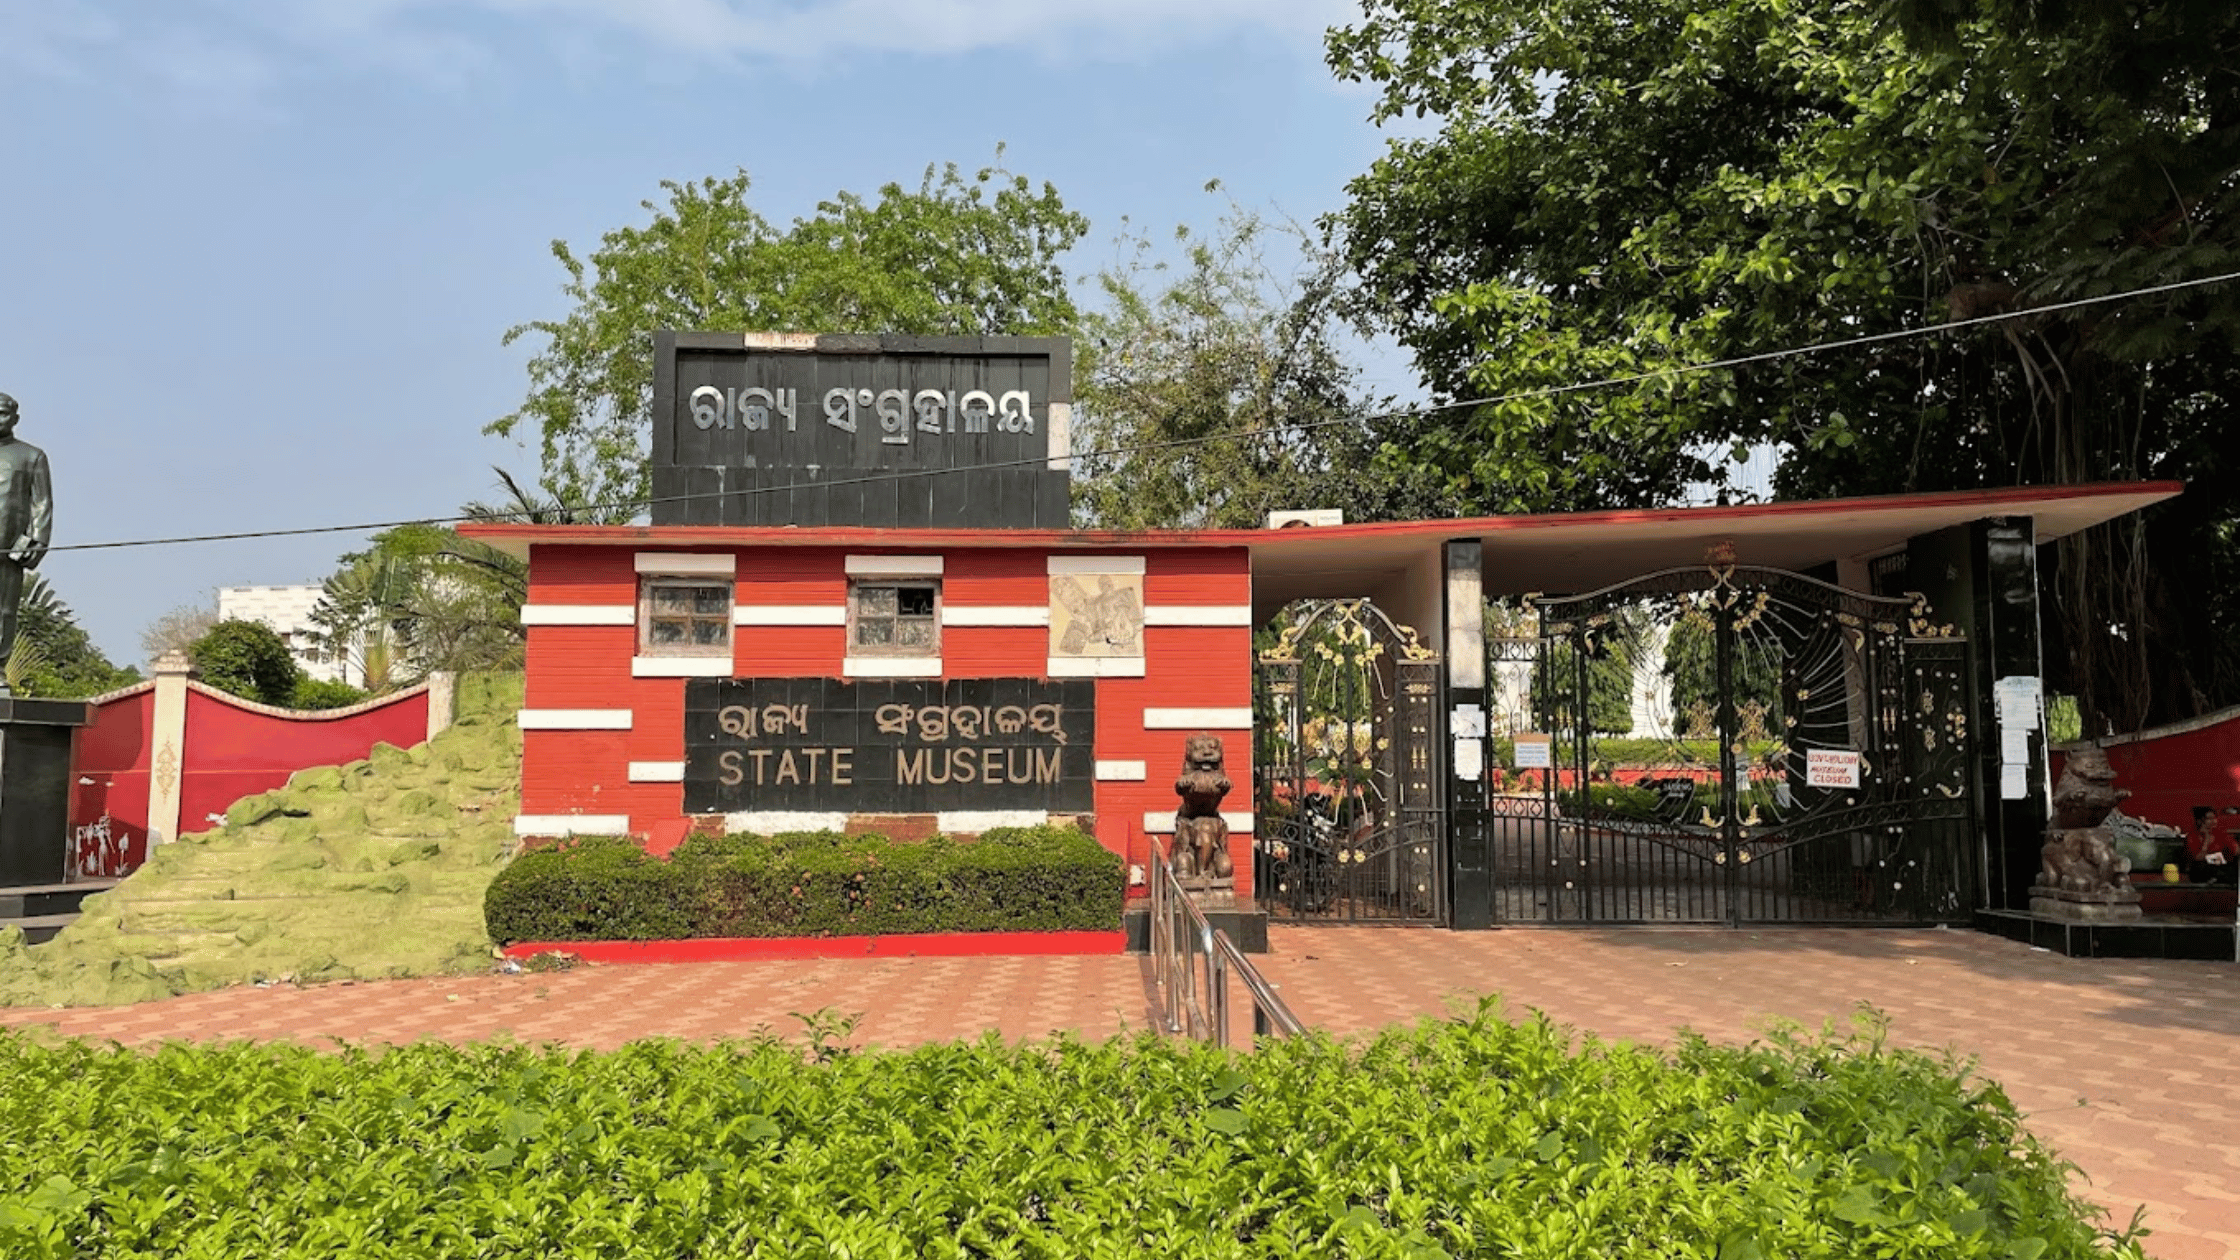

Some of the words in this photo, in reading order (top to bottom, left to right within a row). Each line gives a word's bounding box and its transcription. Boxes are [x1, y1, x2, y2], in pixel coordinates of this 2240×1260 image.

[690, 386, 797, 431] ରାଜ୍ୟ
[718, 703, 809, 740] ରାଜ୍ୟ
[719, 746, 854, 786] STATE
[897, 746, 1063, 785] MUSEUM
[1813, 774, 1852, 784] CLOSED
